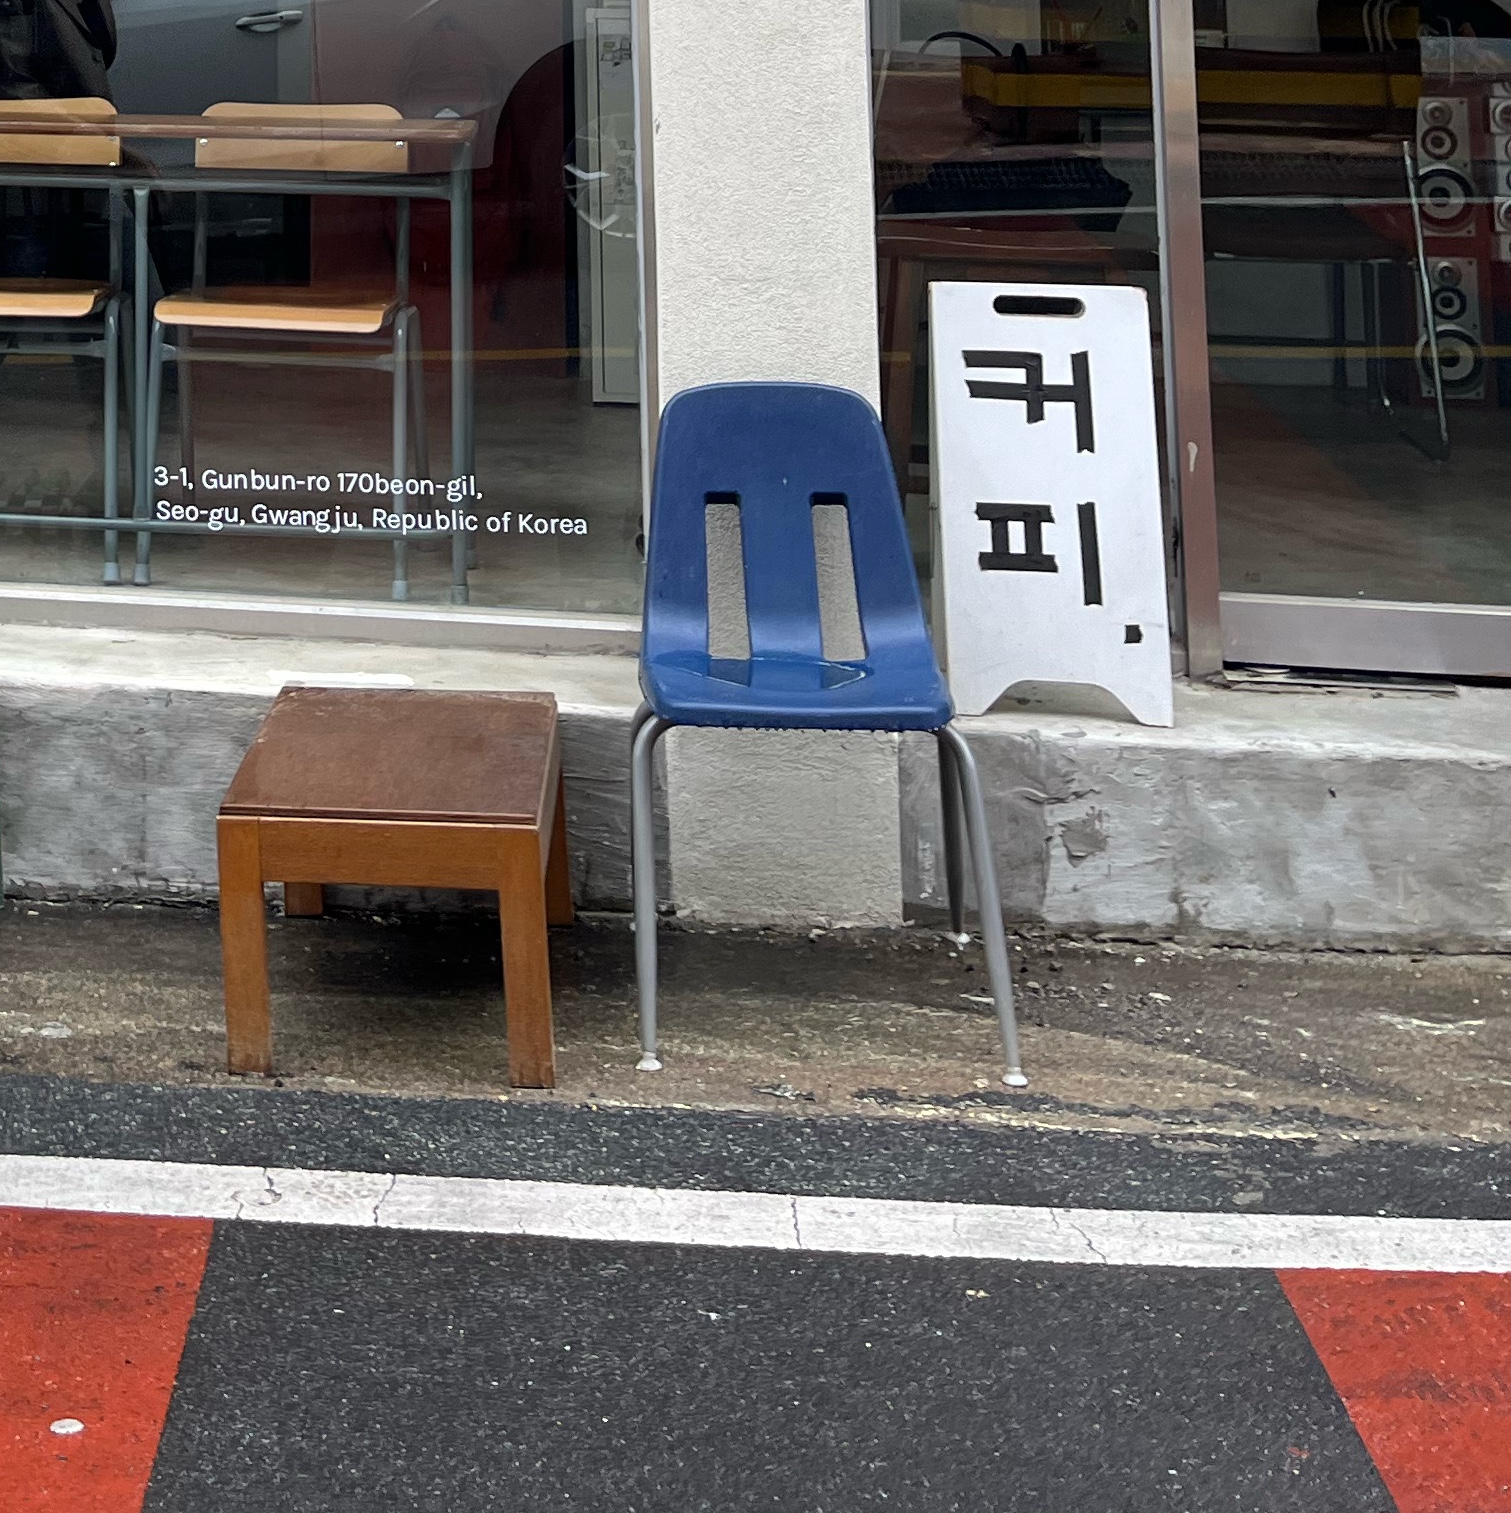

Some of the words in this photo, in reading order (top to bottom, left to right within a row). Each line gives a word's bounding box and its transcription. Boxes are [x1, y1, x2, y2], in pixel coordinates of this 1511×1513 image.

[153, 466, 193, 489] 3-1,
[201, 469, 331, 492] Gunbun-ro
[337, 472, 483, 502] 170beon-gil,
[156, 500, 245, 527] Seo-gu,
[251, 503, 363, 533] Gwangju,
[372, 508, 478, 535] Republic
[486, 512, 511, 533] of
[518, 513, 588, 535] Korea
